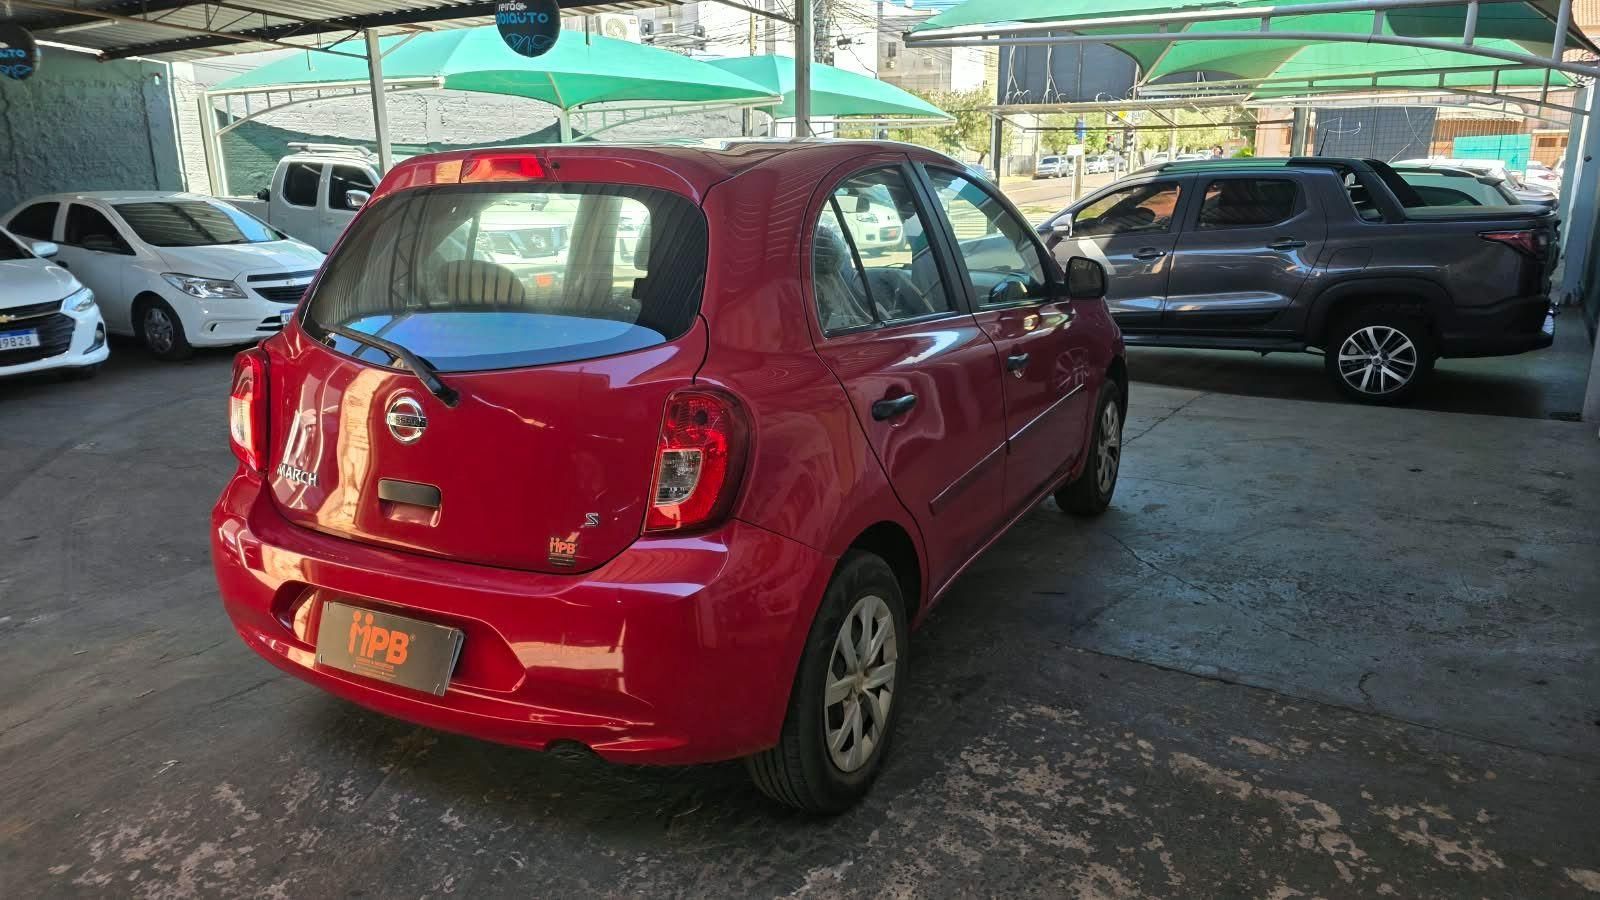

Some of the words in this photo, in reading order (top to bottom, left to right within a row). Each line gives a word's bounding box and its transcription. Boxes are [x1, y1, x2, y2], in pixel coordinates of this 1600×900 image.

[276, 462, 317, 487] MARCH
[584, 512, 600, 527] S
[348, 610, 410, 665] MPB
